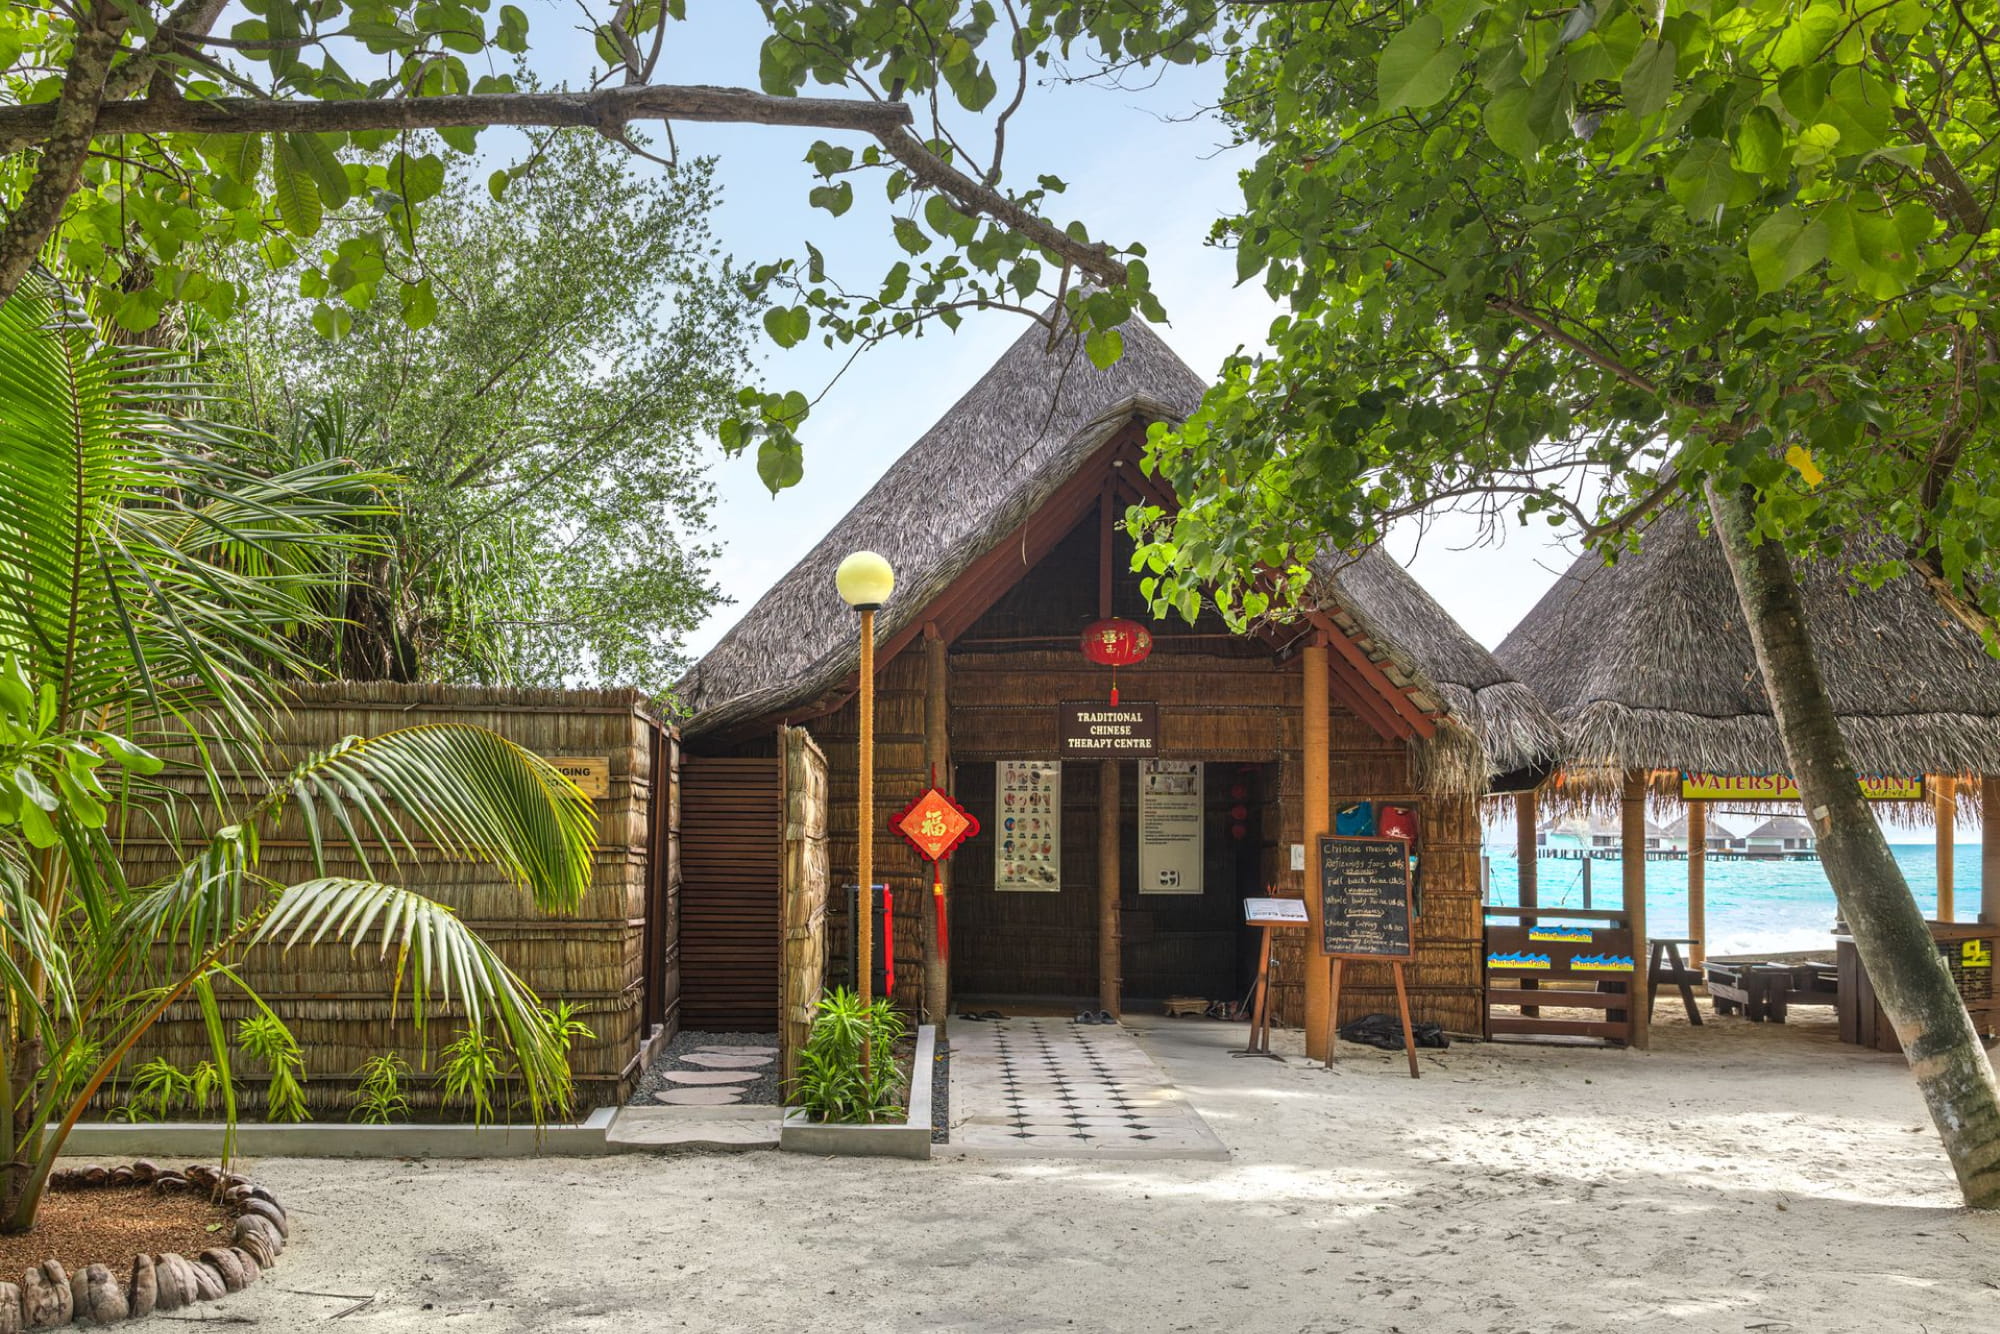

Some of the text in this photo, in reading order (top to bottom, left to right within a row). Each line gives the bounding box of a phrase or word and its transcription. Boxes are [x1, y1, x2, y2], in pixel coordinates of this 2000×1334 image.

[1077, 712, 1143, 722] TRADITIONAL
[1090, 725, 1132, 735] CHINESE
[1068, 738, 1152, 748] THERAPY CENTRE
[1686, 772, 1916, 795] WATERSP OINT
[921, 810, 947, 836] 福
[1324, 843, 1361, 854] Chinese
